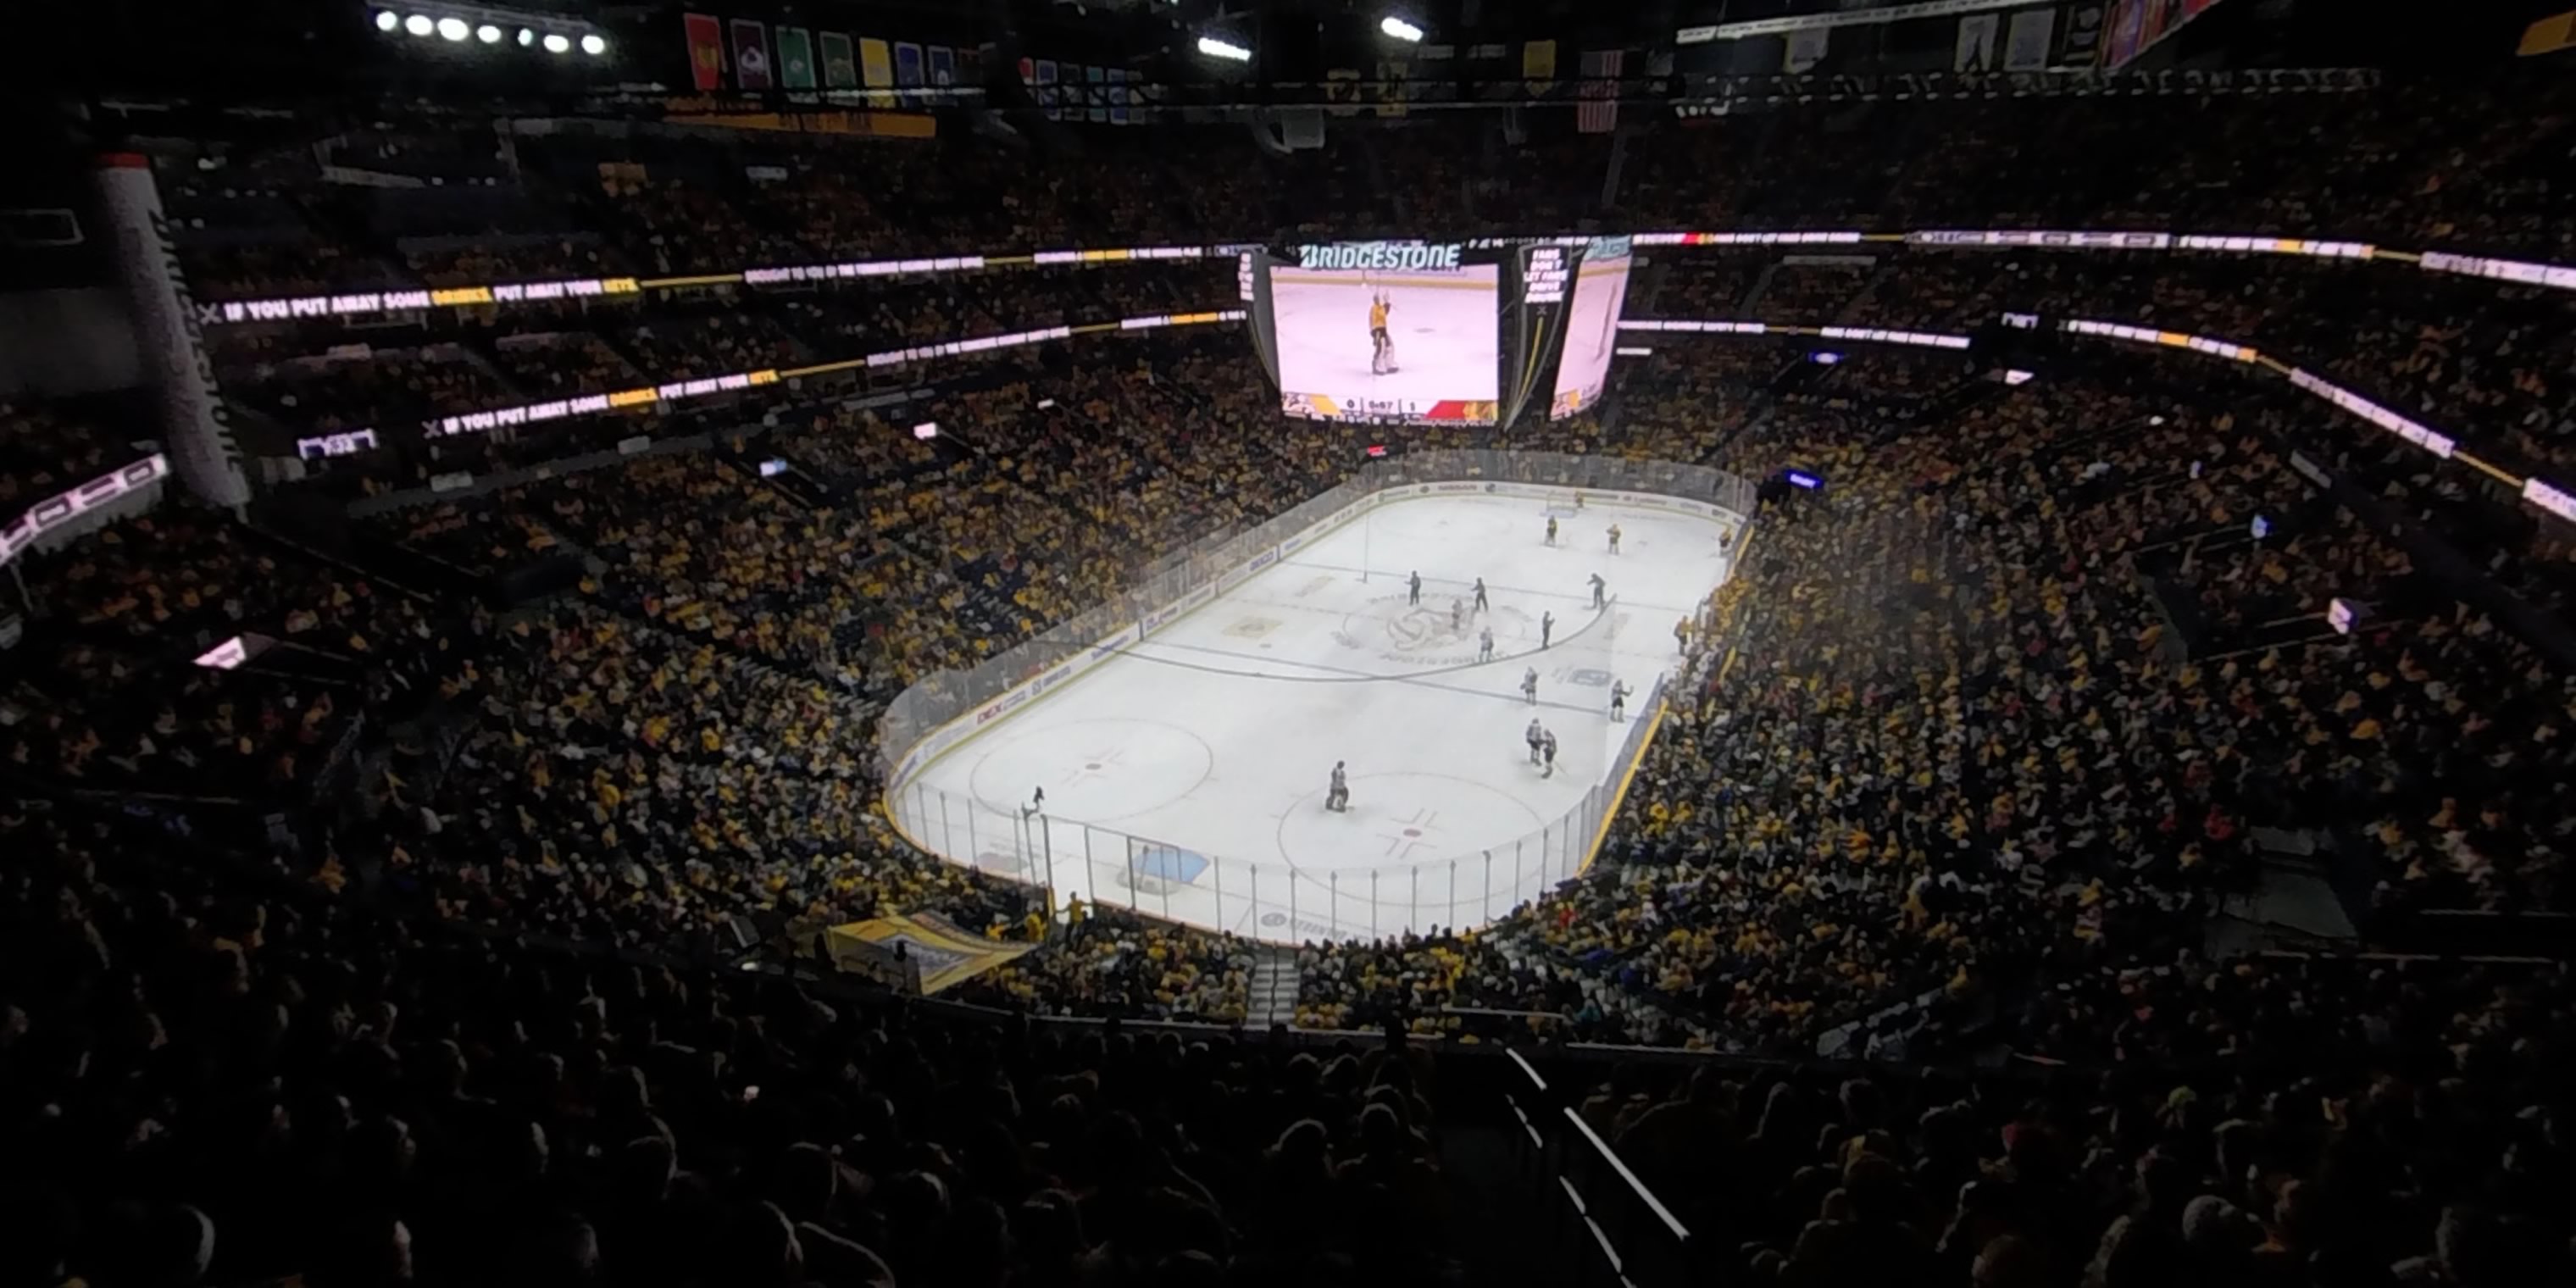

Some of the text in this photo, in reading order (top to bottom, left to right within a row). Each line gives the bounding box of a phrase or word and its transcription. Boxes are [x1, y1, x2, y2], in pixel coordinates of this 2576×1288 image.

[1298, 243, 1462, 269] BRIDGESTONE
[224, 303, 244, 321] IF
[247, 299, 288, 320] YOU
[291, 297, 327, 317] PUT
[332, 294, 380, 313] AWAY
[384, 290, 430, 308] SOME
[493, 283, 523, 303] PUT
[461, 411, 495, 431] YOU
[497, 407, 525, 425] PUT
[528, 401, 568, 420] AWAY
